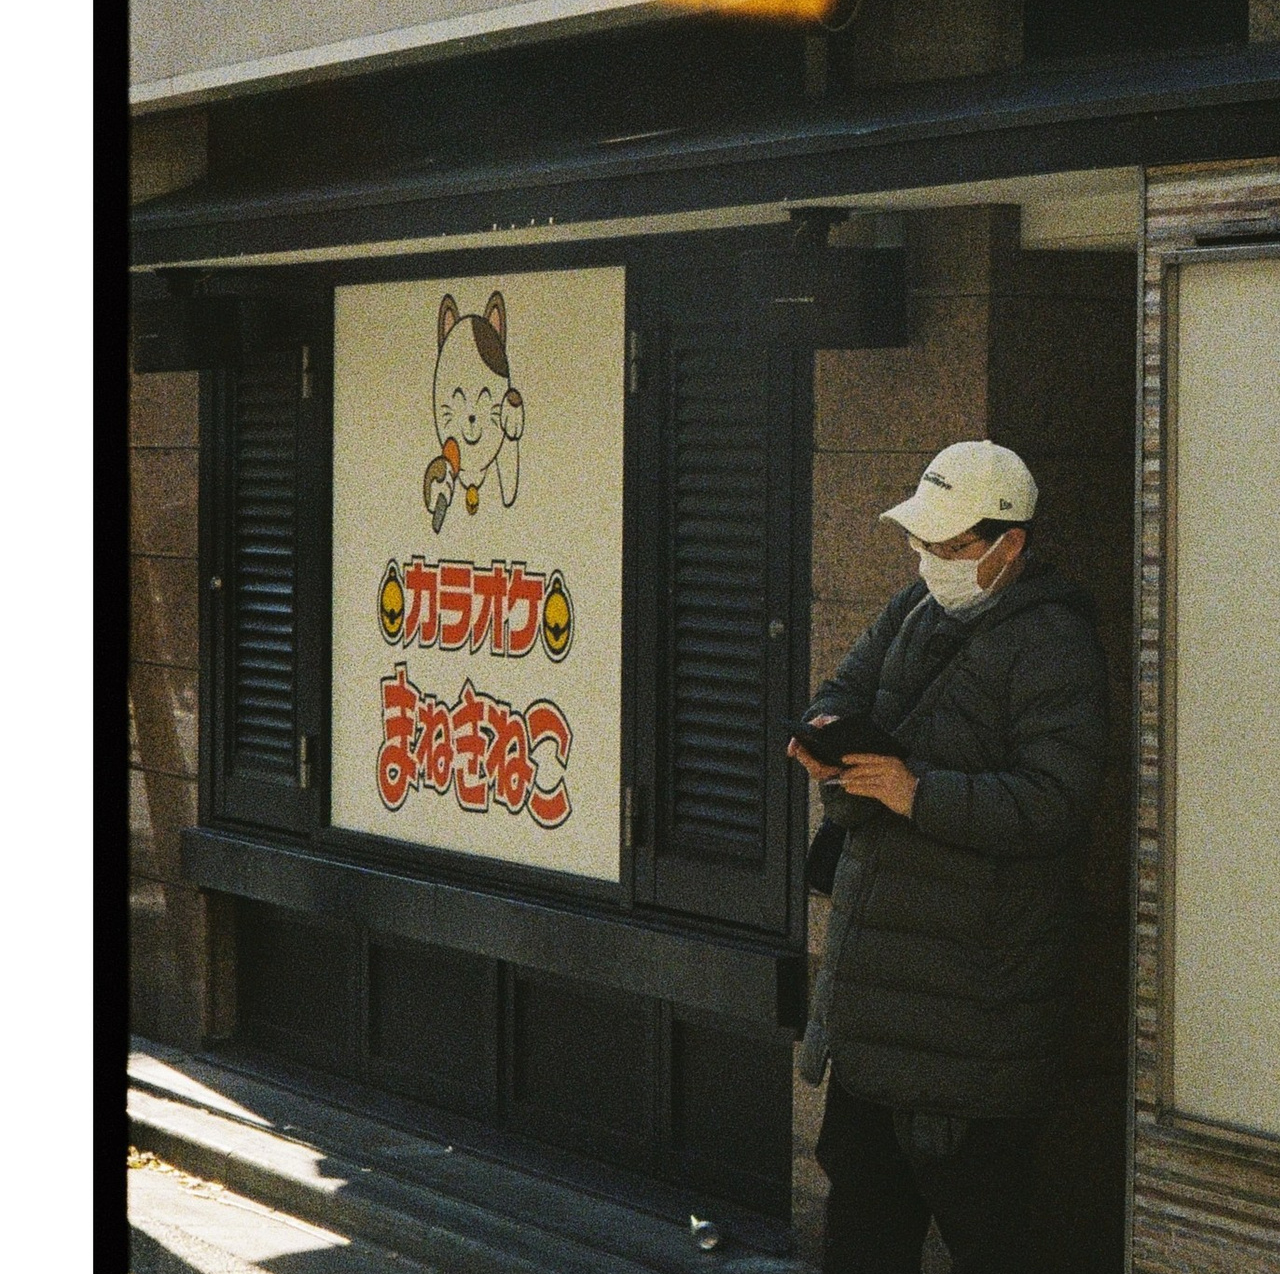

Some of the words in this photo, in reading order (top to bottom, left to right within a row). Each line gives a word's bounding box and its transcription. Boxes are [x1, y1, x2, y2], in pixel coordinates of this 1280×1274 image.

[402, 556, 546, 657] カラオケ
[377, 663, 573, 829] まねきねこ
